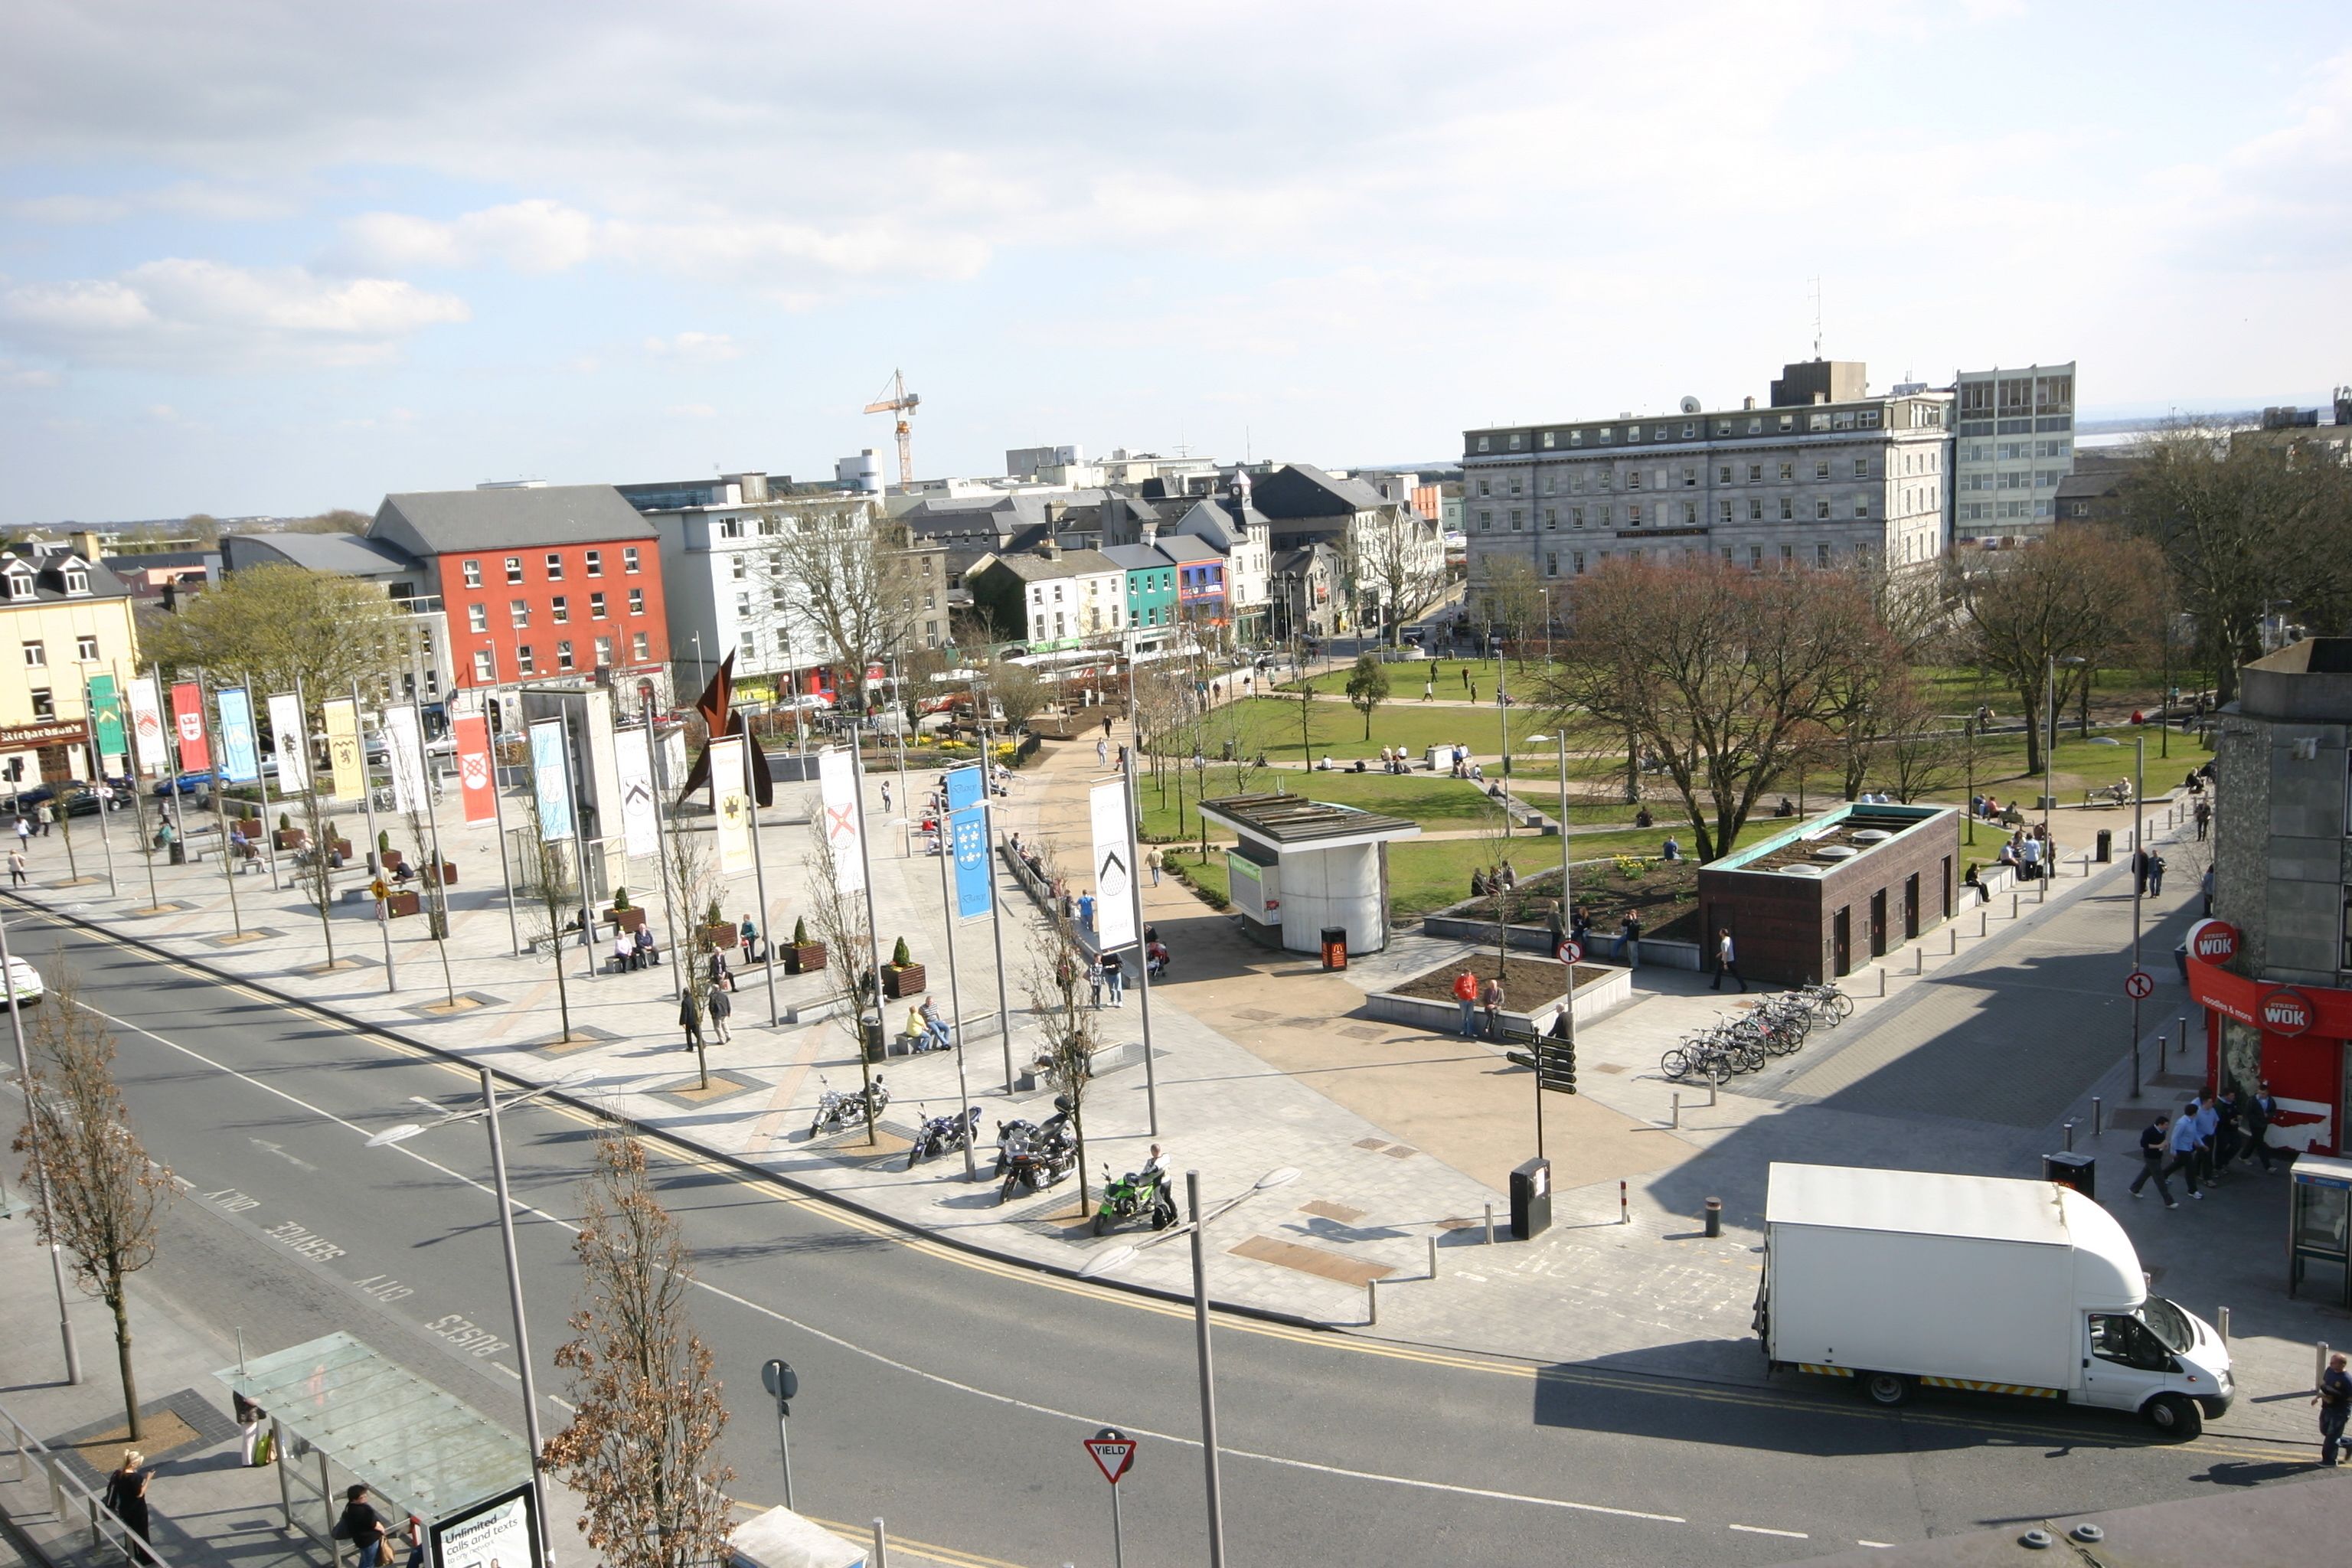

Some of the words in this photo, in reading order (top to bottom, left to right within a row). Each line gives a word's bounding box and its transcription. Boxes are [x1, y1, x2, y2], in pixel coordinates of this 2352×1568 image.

[1, 724, 82, 741] Richardson's
[2199, 938, 2232, 955] WOK
[2202, 995, 2228, 1011] noodles
[2229, 1005, 2235, 1014] &
[2235, 1009, 2252, 1022] more
[2265, 1008, 2305, 1026] WOK
[203, 1188, 261, 1212] ONLY
[264, 1221, 347, 1262] SERVICE
[352, 1274, 414, 1302] CITY
[425, 1314, 510, 1357] BUSES
[1095, 1446, 1125, 1455] YIELD
[446, 1514, 498, 1544] Unlimited
[446, 1537, 469, 1556] calls
[471, 1530, 491, 1545] and
[493, 1518, 518, 1535] texts
[456, 1551, 468, 1562] any
